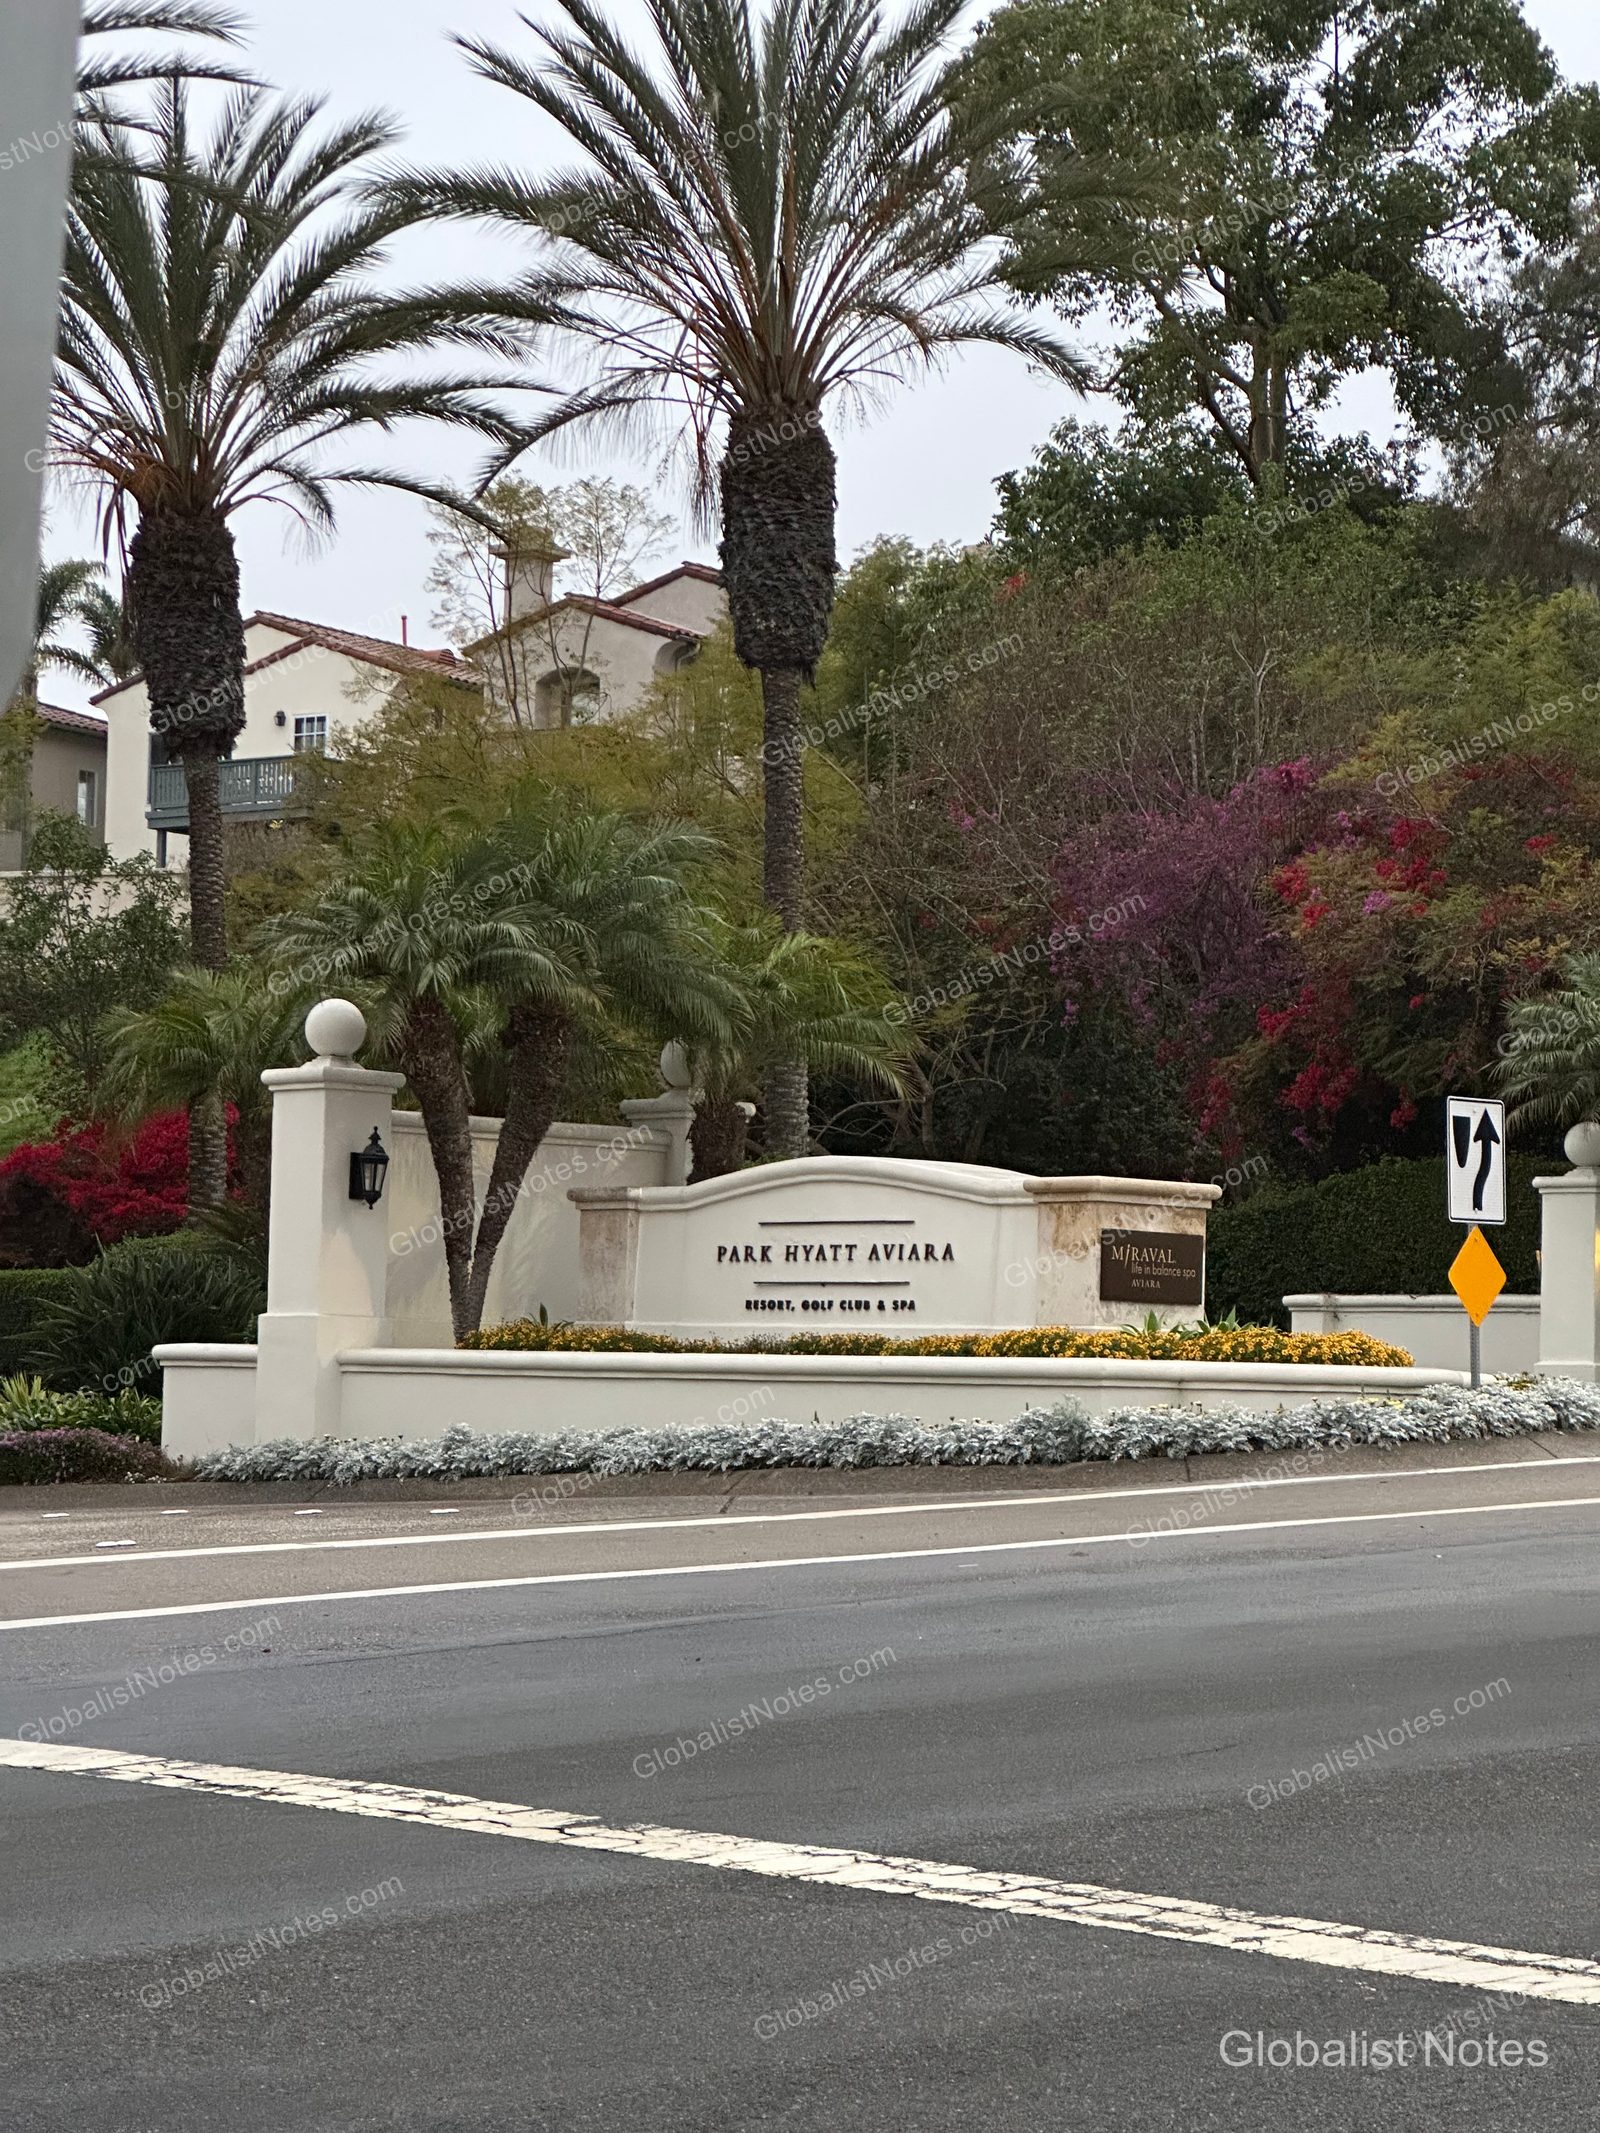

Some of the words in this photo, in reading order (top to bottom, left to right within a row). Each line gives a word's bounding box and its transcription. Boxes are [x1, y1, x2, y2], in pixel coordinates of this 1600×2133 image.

[717, 1245, 772, 1263] PARK
[785, 1244, 858, 1263] HYATT
[868, 1243, 955, 1262] AVIARA
[1131, 1262, 1142, 1274] life
[1144, 1264, 1151, 1275] in
[1152, 1263, 1181, 1277] balance
[1183, 1268, 1196, 1280] spa
[1131, 1279, 1161, 1289] AVIARA
[745, 1300, 795, 1312] RESORT,
[801, 1300, 834, 1311] GOLF
[839, 1300, 870, 1311] CLUB
[877, 1300, 886, 1311] &
[892, 1299, 916, 1311] SPA
